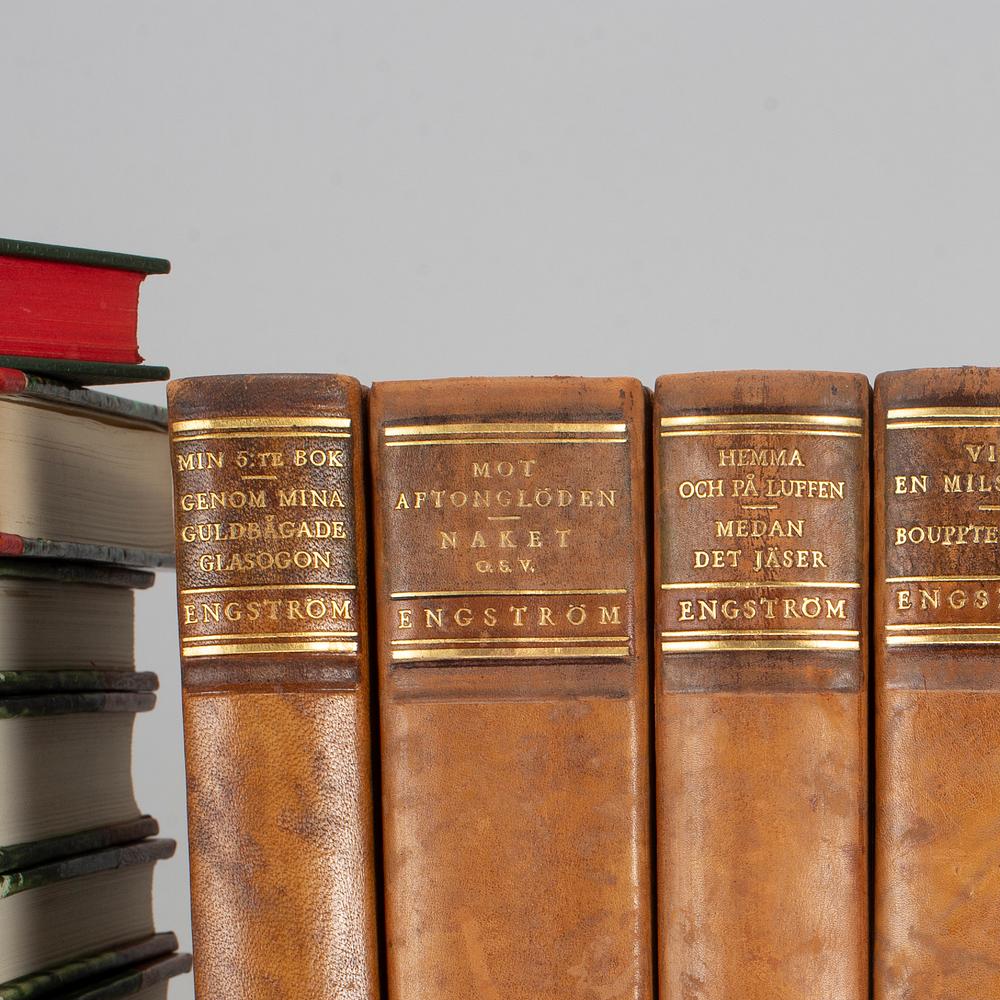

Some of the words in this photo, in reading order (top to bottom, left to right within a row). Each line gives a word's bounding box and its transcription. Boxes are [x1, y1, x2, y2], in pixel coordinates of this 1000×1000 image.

[177, 451, 224, 471] MIN
[295, 450, 343, 467] BOK
[473, 459, 537, 478] MOT
[718, 449, 806, 467] HEMMA
[678, 480, 723, 499] OCH
[732, 474, 759, 497] PÅ
[766, 480, 845, 499] LUFFEN
[894, 475, 928, 495] EN
[181, 490, 266, 511] GENOM
[278, 489, 345, 508] MINA
[395, 488, 617, 510] AFTONGLÖDEN
[182, 515, 346, 542] GULDBÅGADE
[440, 529, 571, 549] NAKET
[715, 520, 805, 538] MEDAN
[694, 550, 742, 569] DET
[753, 547, 827, 572] JÄSER
[184, 598, 351, 625] ENGSTRÖM
[398, 603, 621, 629] ENGSTRÖM
[678, 597, 847, 622] ENGSTRÖM
